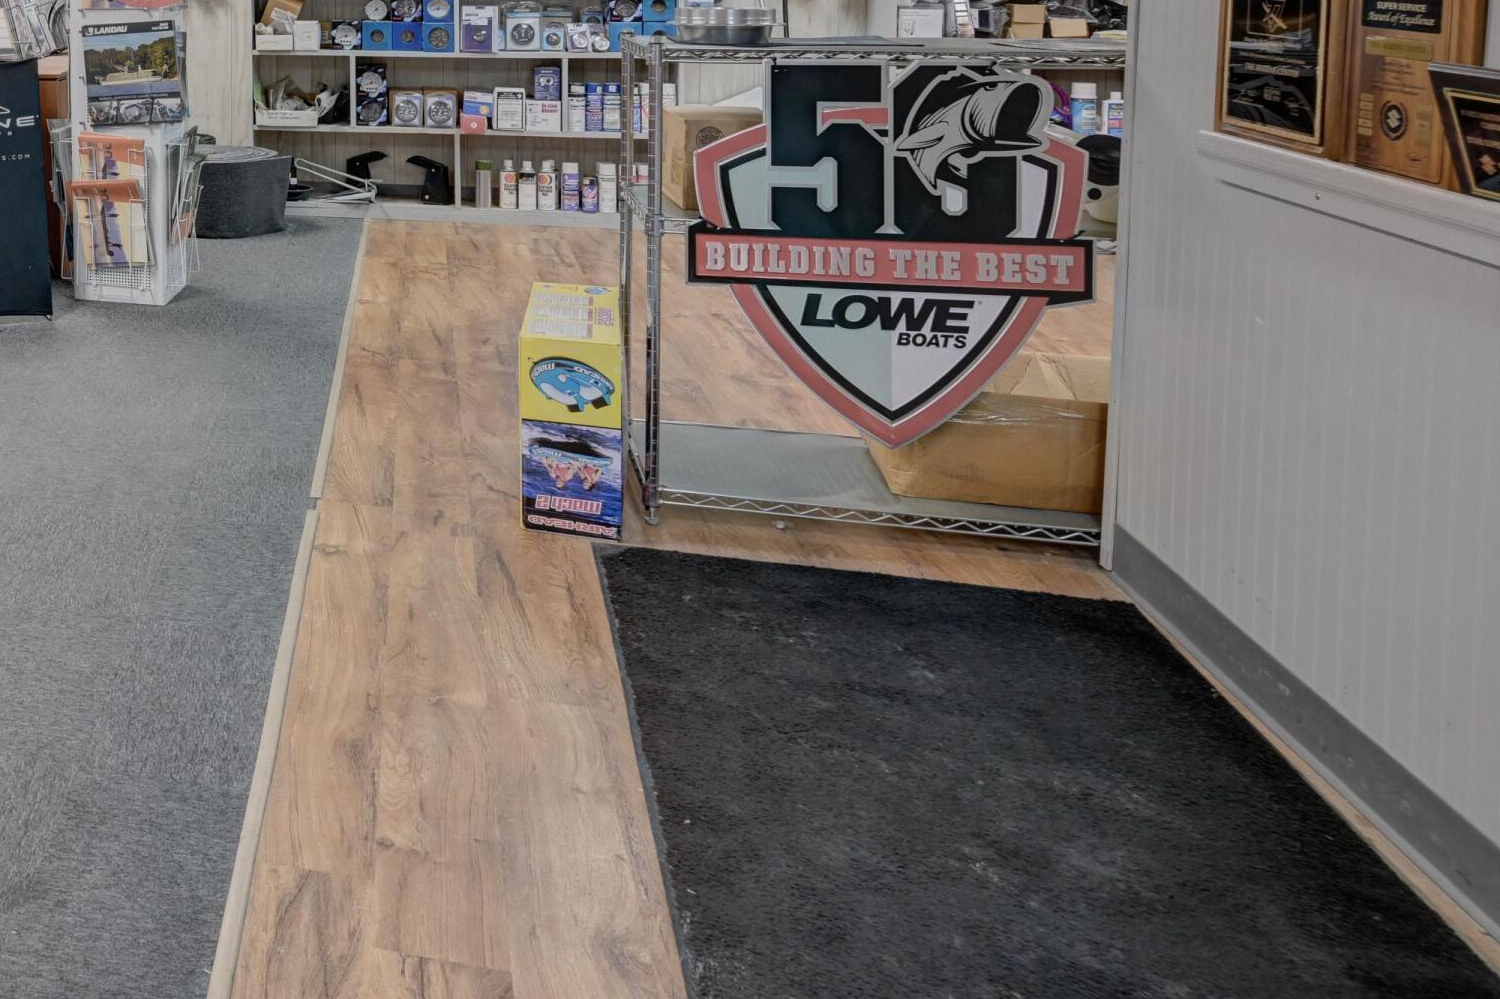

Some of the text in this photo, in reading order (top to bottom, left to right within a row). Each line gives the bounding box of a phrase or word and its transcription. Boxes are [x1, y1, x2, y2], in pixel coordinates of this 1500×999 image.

[1366, 11, 1390, 22] Award
[1377, 1, 1428, 13] SUPER SERVICE
[94, 25, 128, 35] LANDAU
[705, 241, 1075, 285] BUILDING THE BEST
[800, 293, 975, 335] LOWE
[896, 332, 968, 350] BOATS
[535, 494, 602, 515] mach 2
[527, 514, 615, 537] AIRHEAD
